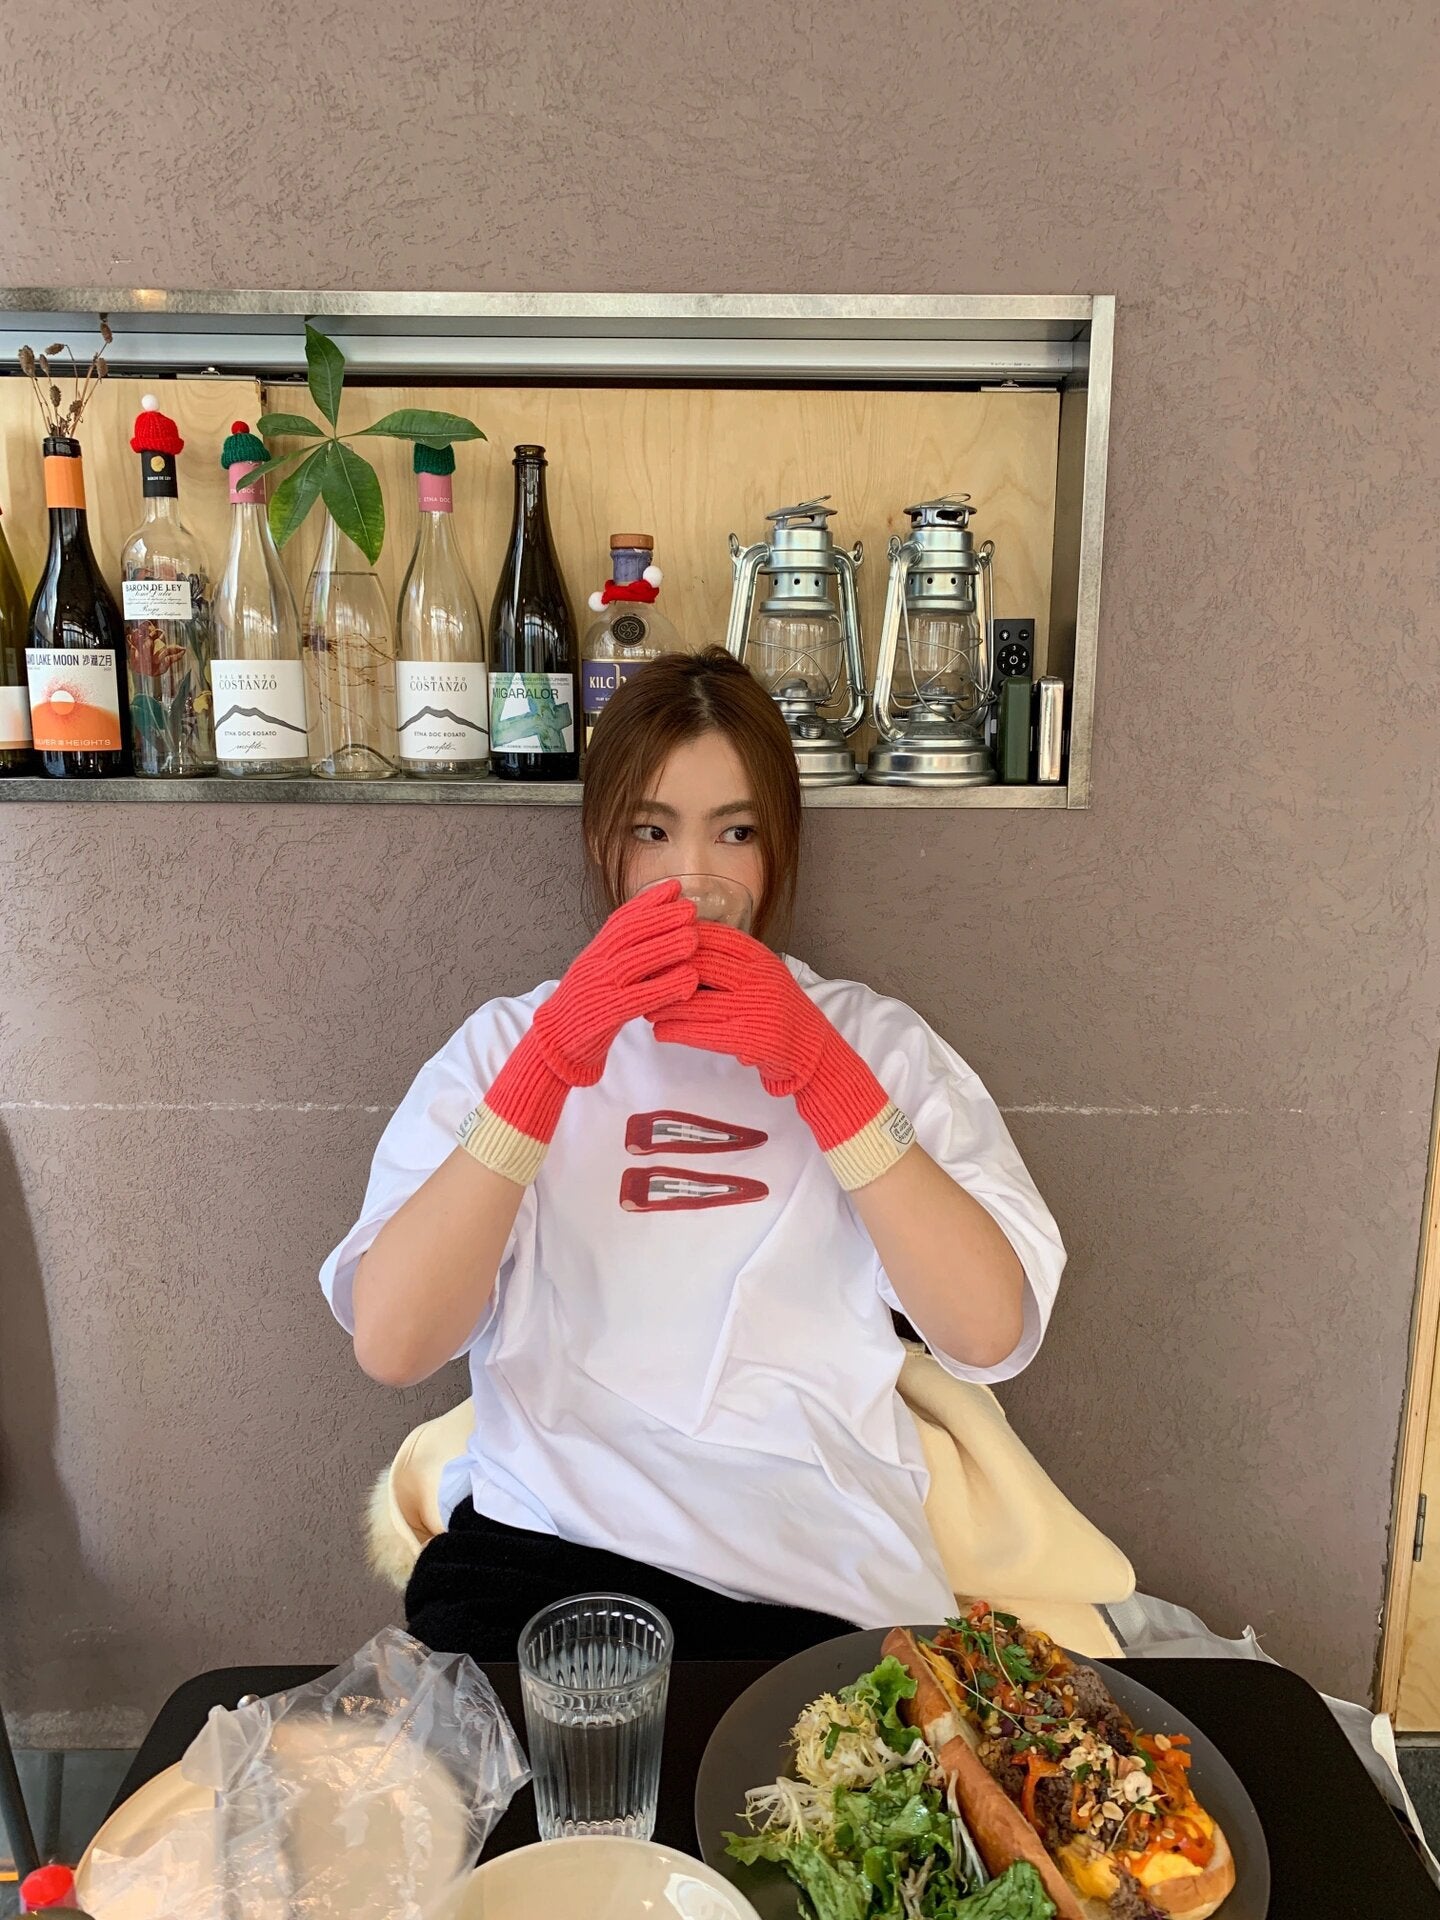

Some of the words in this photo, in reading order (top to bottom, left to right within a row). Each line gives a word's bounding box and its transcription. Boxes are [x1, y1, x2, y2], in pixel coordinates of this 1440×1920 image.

[151, 584, 163, 592] DE
[36, 654, 51, 666] LAKE
[53, 654, 79, 666] MOON
[219, 680, 277, 690] COSTANZO
[410, 681, 468, 692] COSTANZO
[493, 687, 559, 700] MIGARALOR
